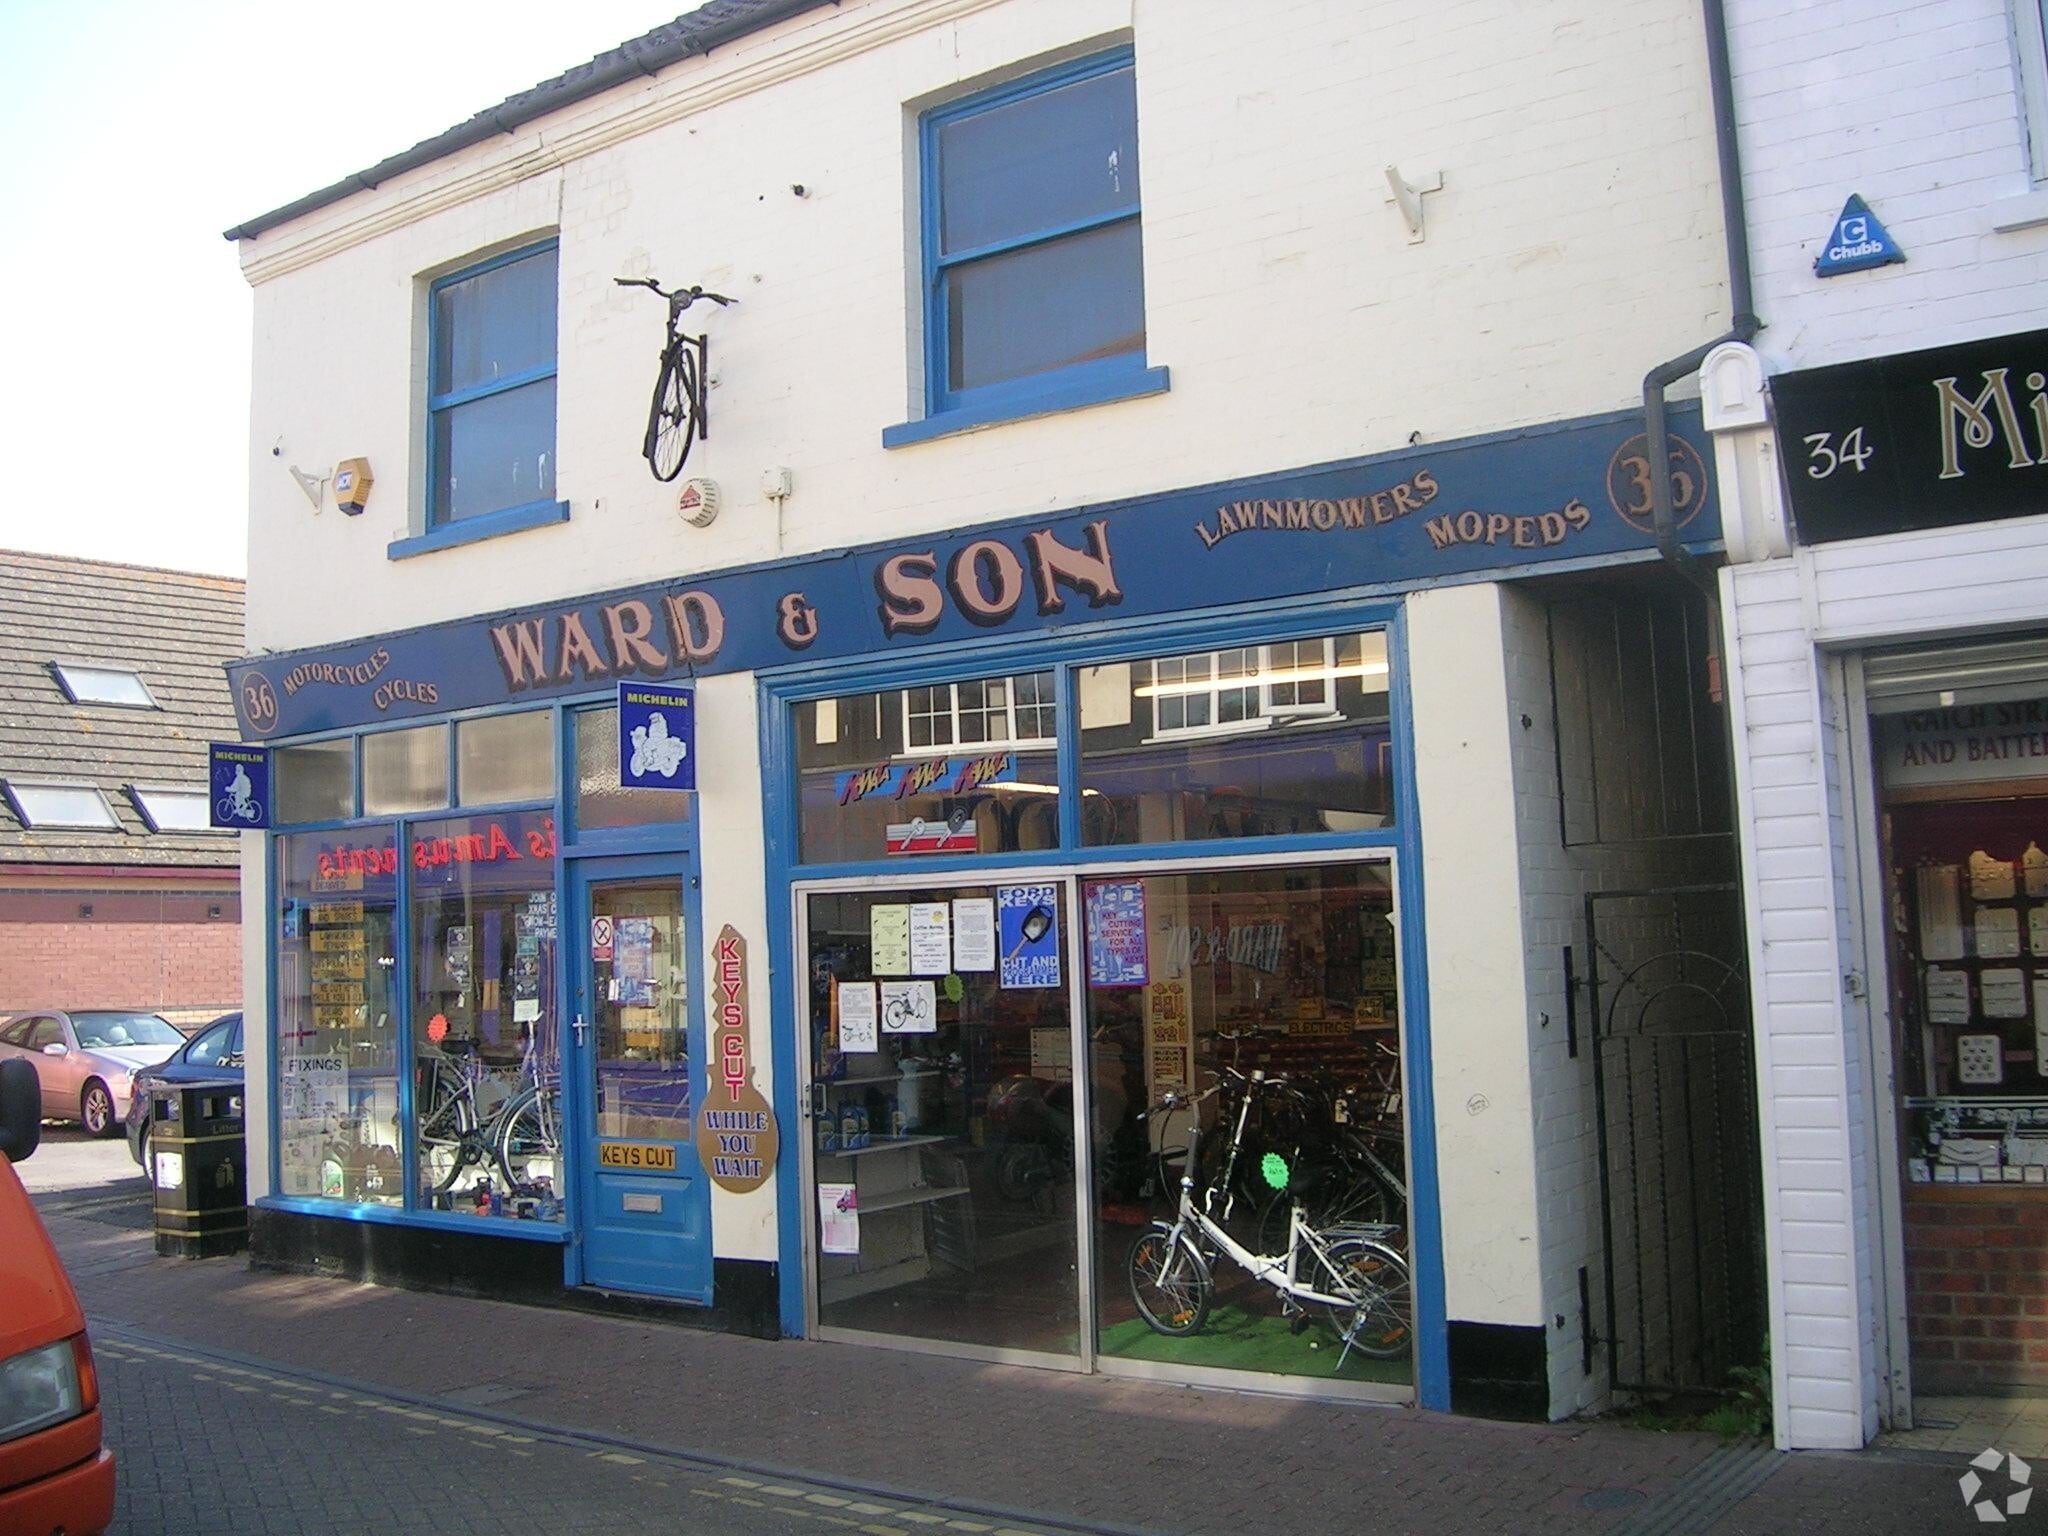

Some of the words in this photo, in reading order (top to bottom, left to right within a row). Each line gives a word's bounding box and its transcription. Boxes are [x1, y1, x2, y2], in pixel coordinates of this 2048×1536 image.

[1829, 240, 1883, 261] Chubb
[1803, 426, 1873, 479] 34
[1933, 368, 2048, 480] Mi
[1620, 449, 1694, 515] 36
[1194, 468, 1439, 550] LAWNMOWERS
[1423, 496, 1591, 550] MOPEDS
[491, 590, 725, 692] WARD
[777, 592, 818, 650] &
[875, 520, 1122, 639] SON
[282, 646, 390, 696] MOTORCYCLES
[244, 683, 275, 720] 36
[374, 679, 438, 710] CYCLES
[626, 692, 688, 707] MICHELIN
[1997, 700, 2048, 725] STR
[215, 749, 265, 763] MICHELIN
[1902, 739, 1955, 767] AND
[1966, 732, 2048, 762] BATTE
[1001, 887, 1055, 898] FORD
[1101, 928, 1131, 937] SERVICE
[1108, 919, 1142, 928] CUTTING
[1003, 956, 1028, 969] CUT
[718, 937, 744, 1029] KEYS
[1003, 975, 1058, 984] HERE
[1289, 1021, 1351, 1034] ELECTRICS
[289, 1058, 342, 1072] FIXINGS
[721, 1034, 745, 1102] CUT
[705, 1109, 769, 1132] WHILE
[717, 1133, 756, 1155] YOU
[602, 1145, 641, 1165] KEYS
[645, 1147, 675, 1167] CUT
[712, 1156, 765, 1178] WAIT
